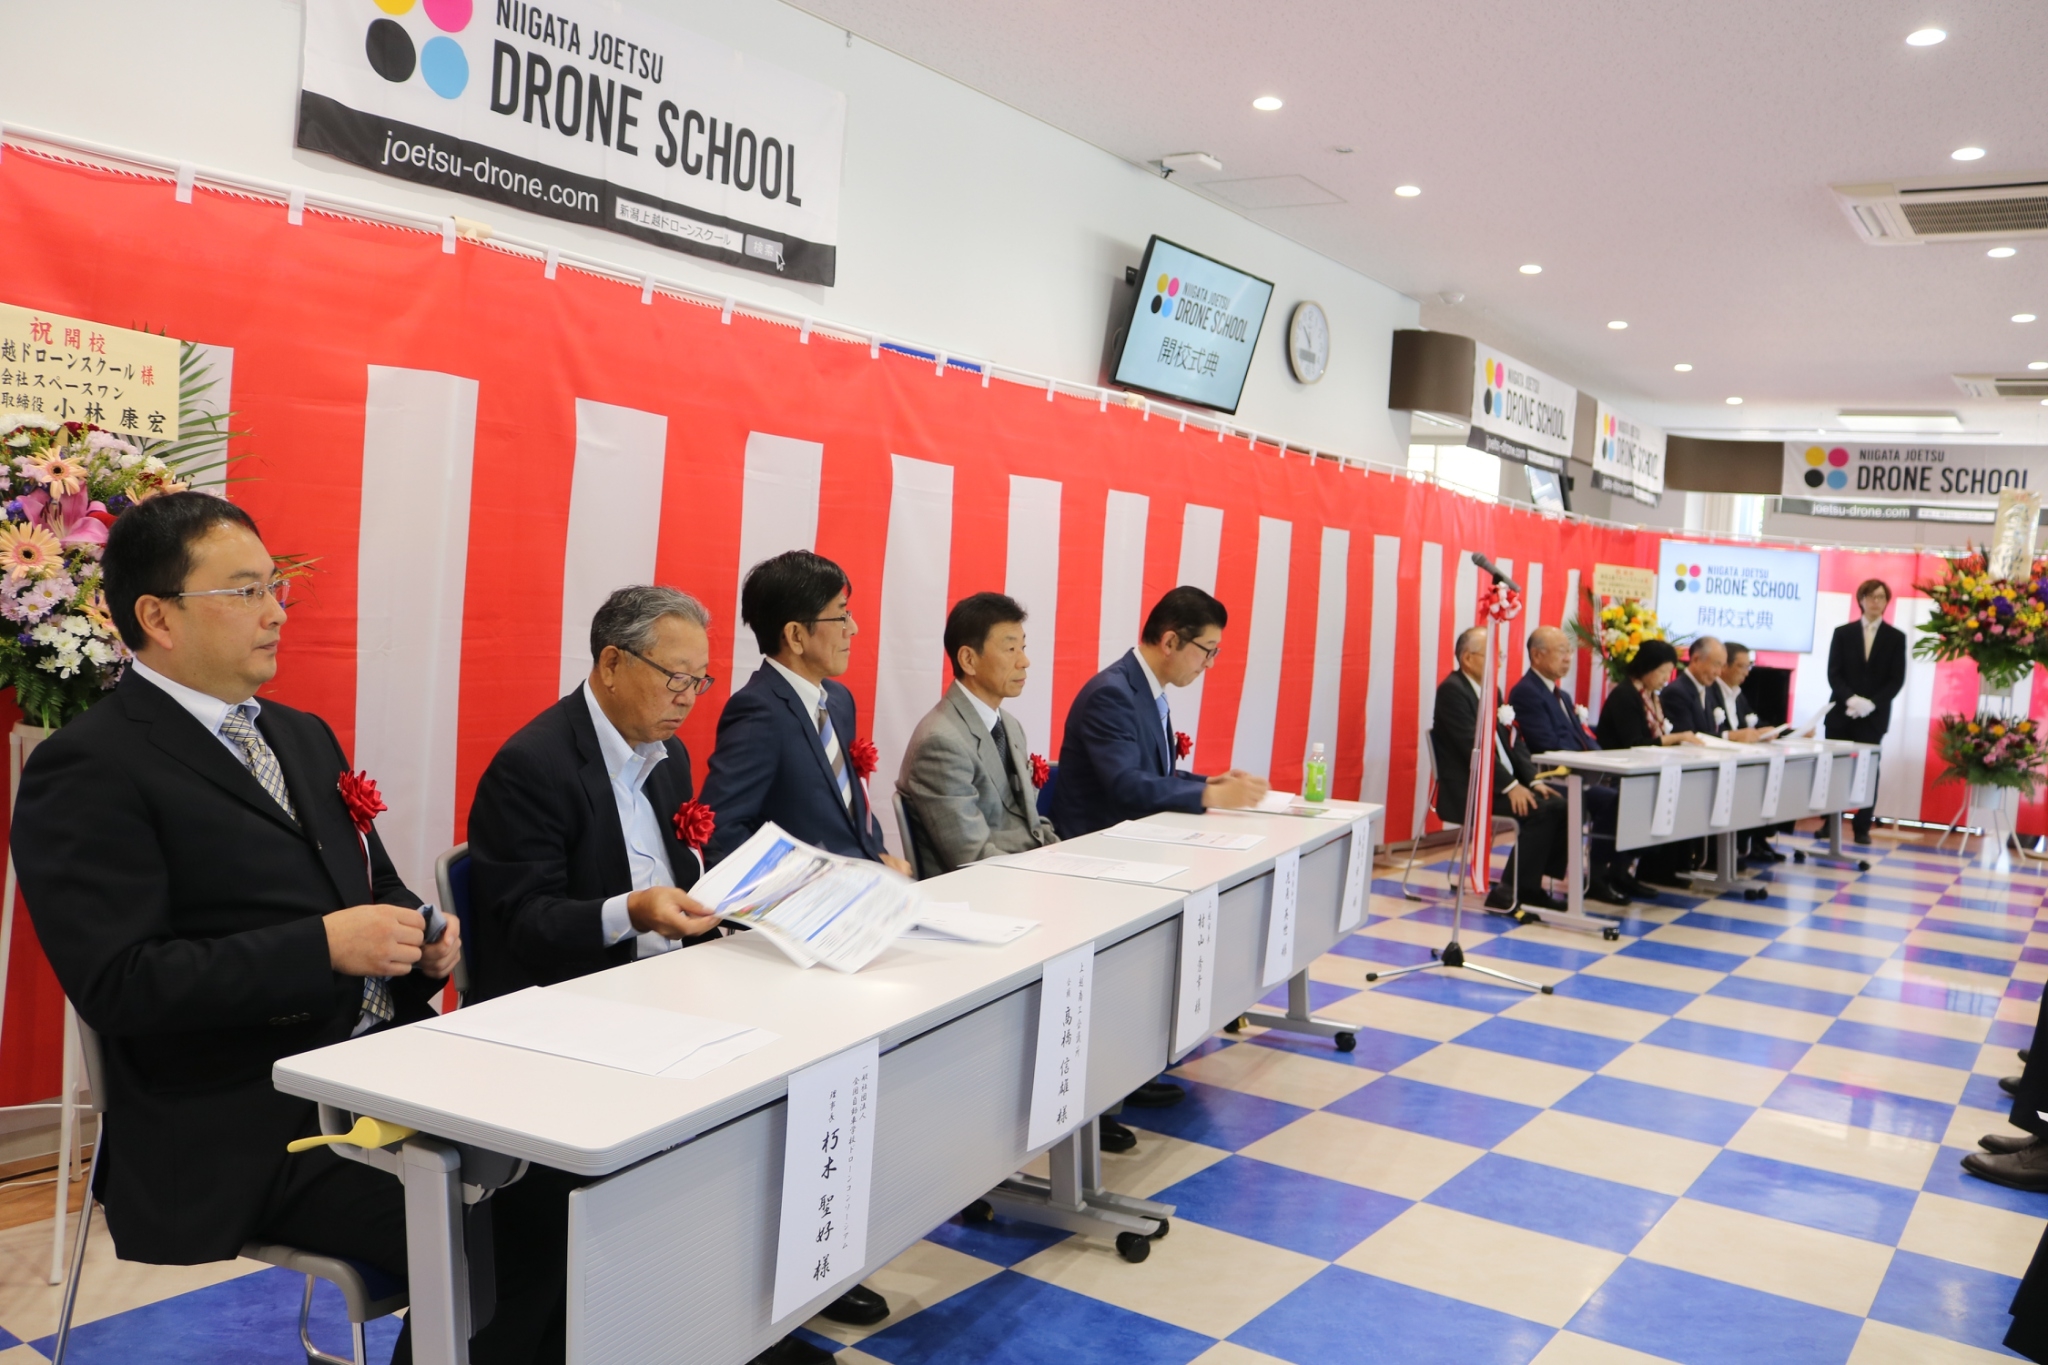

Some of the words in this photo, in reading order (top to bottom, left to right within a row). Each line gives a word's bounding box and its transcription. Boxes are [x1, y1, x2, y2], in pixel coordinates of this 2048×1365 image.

[496, 0, 580, 55] NIIGATA
[589, 30, 663, 84] JOETSU
[490, 39, 643, 156] DRONE
[655, 99, 802, 207] SCHOOL
[381, 130, 600, 214] joetsu-drone.com
[619, 203, 731, 246] 新潟上越ドローンスクール
[753, 241, 775, 258] 検索
[1182, 282, 1209, 302] NIIGATA
[1209, 291, 1231, 310] JOETSU
[1175, 297, 1212, 330] DRONE
[1210, 310, 1248, 343] SCHOOL
[1157, 336, 1220, 377] 開校式典
[1, 367, 124, 400] 会社スペースワン
[1859, 449, 1900, 461] NIIGATA
[1904, 450, 1945, 462] JOETSU
[1857, 465, 1933, 492] DRONE
[1811, 501, 1910, 518] joetsu-drone.com
[1707, 565, 1738, 577] NIIGATA
[1741, 568, 1769, 578] JOETSU
[1705, 577, 1747, 596] DRONE
[1753, 580, 1801, 600] SCHOOL
[1697, 605, 1773, 630] 開校式典
